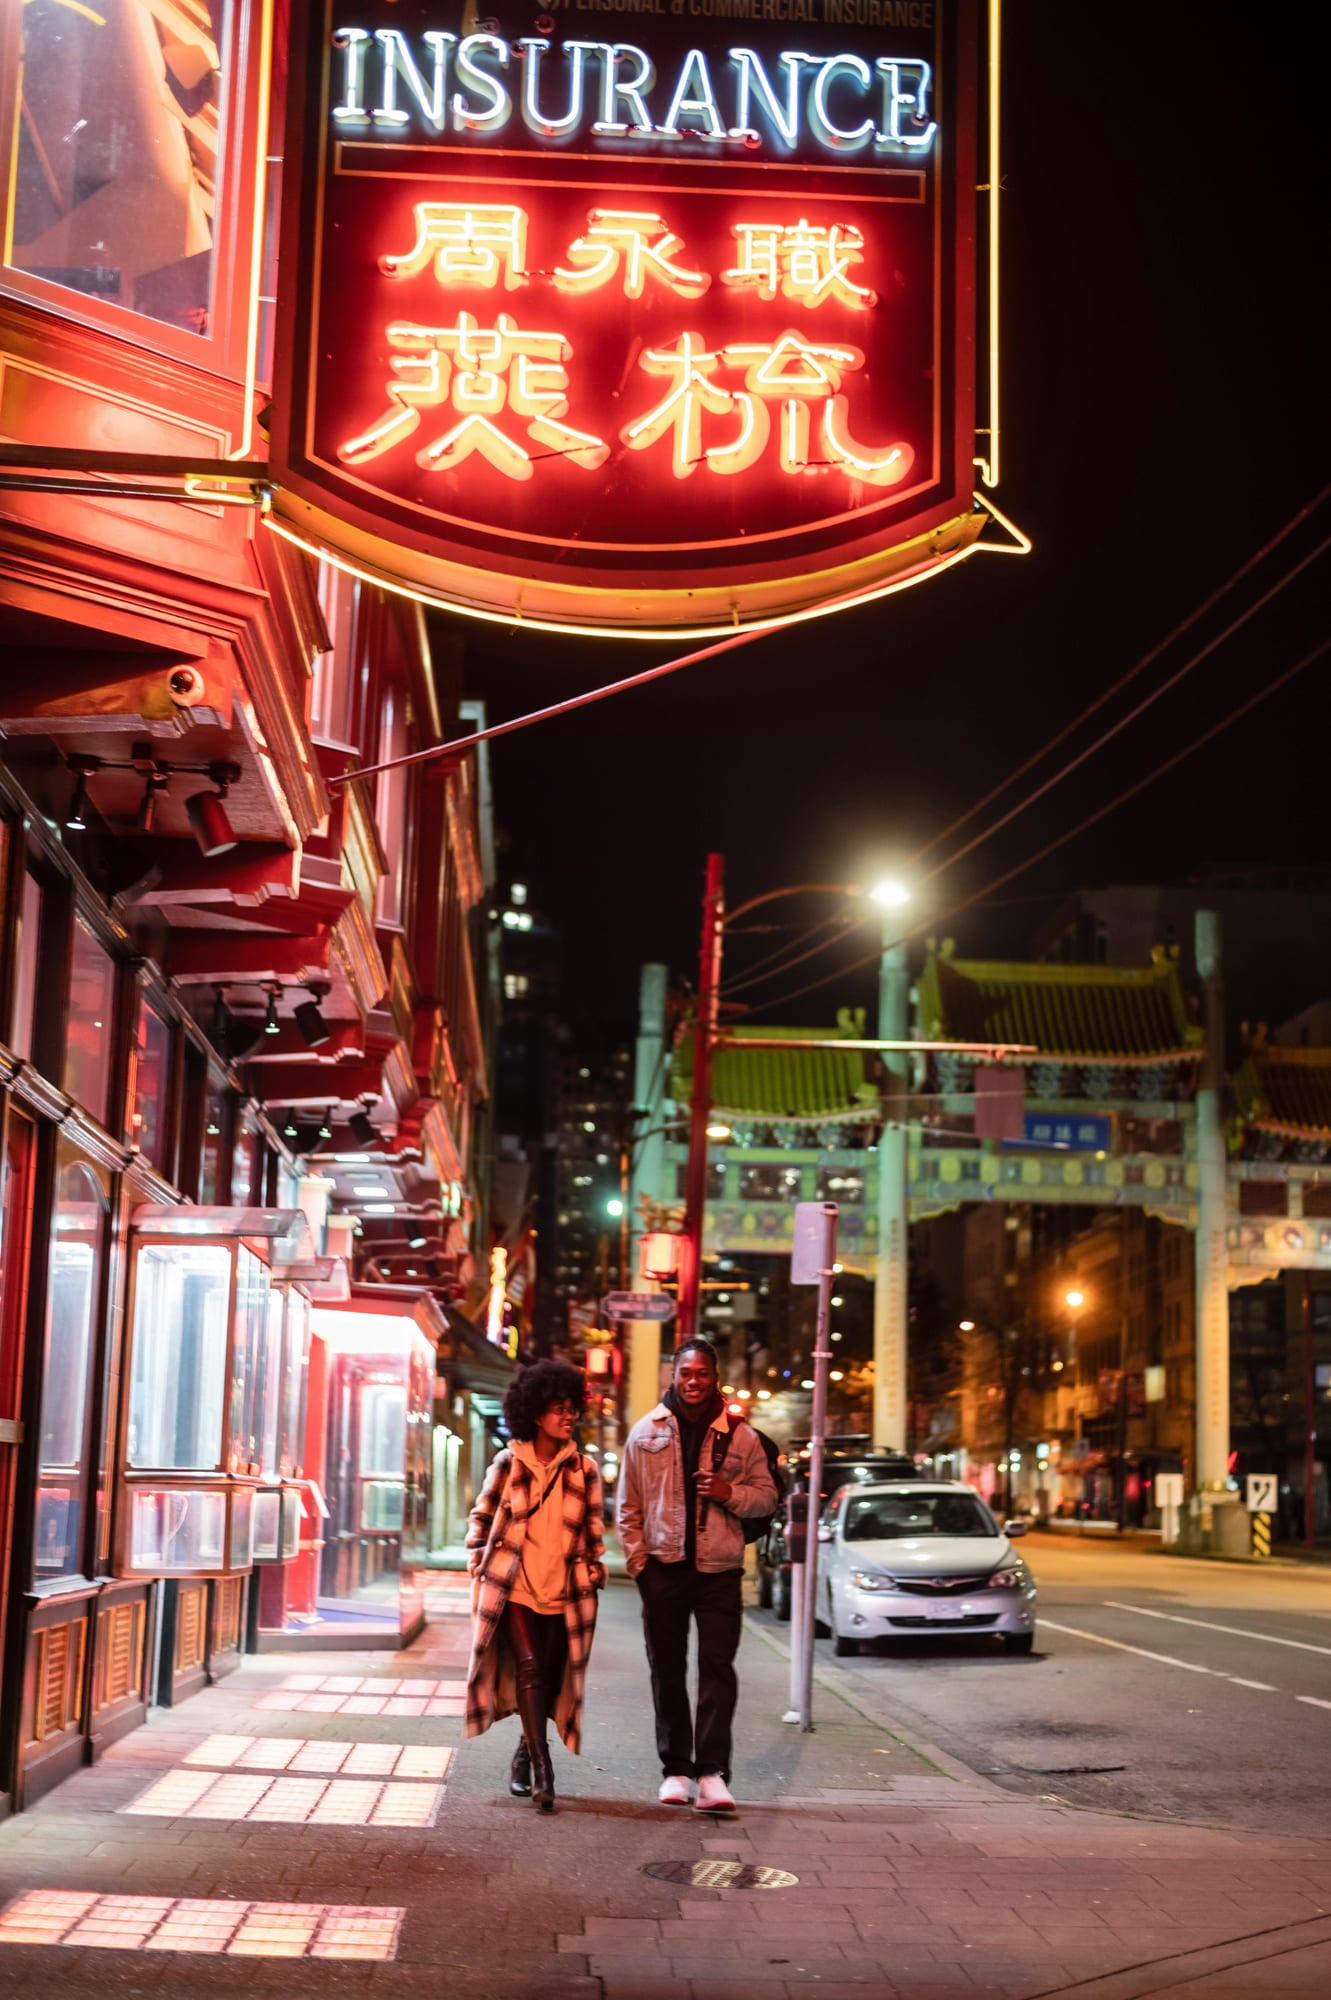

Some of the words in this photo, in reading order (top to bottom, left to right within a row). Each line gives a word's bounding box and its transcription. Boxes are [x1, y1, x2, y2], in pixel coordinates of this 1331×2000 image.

[688, 0, 819, 22] COMMERCIAL
[823, 0, 933, 28] INSURANCE
[332, 27, 938, 153] INSURANCE
